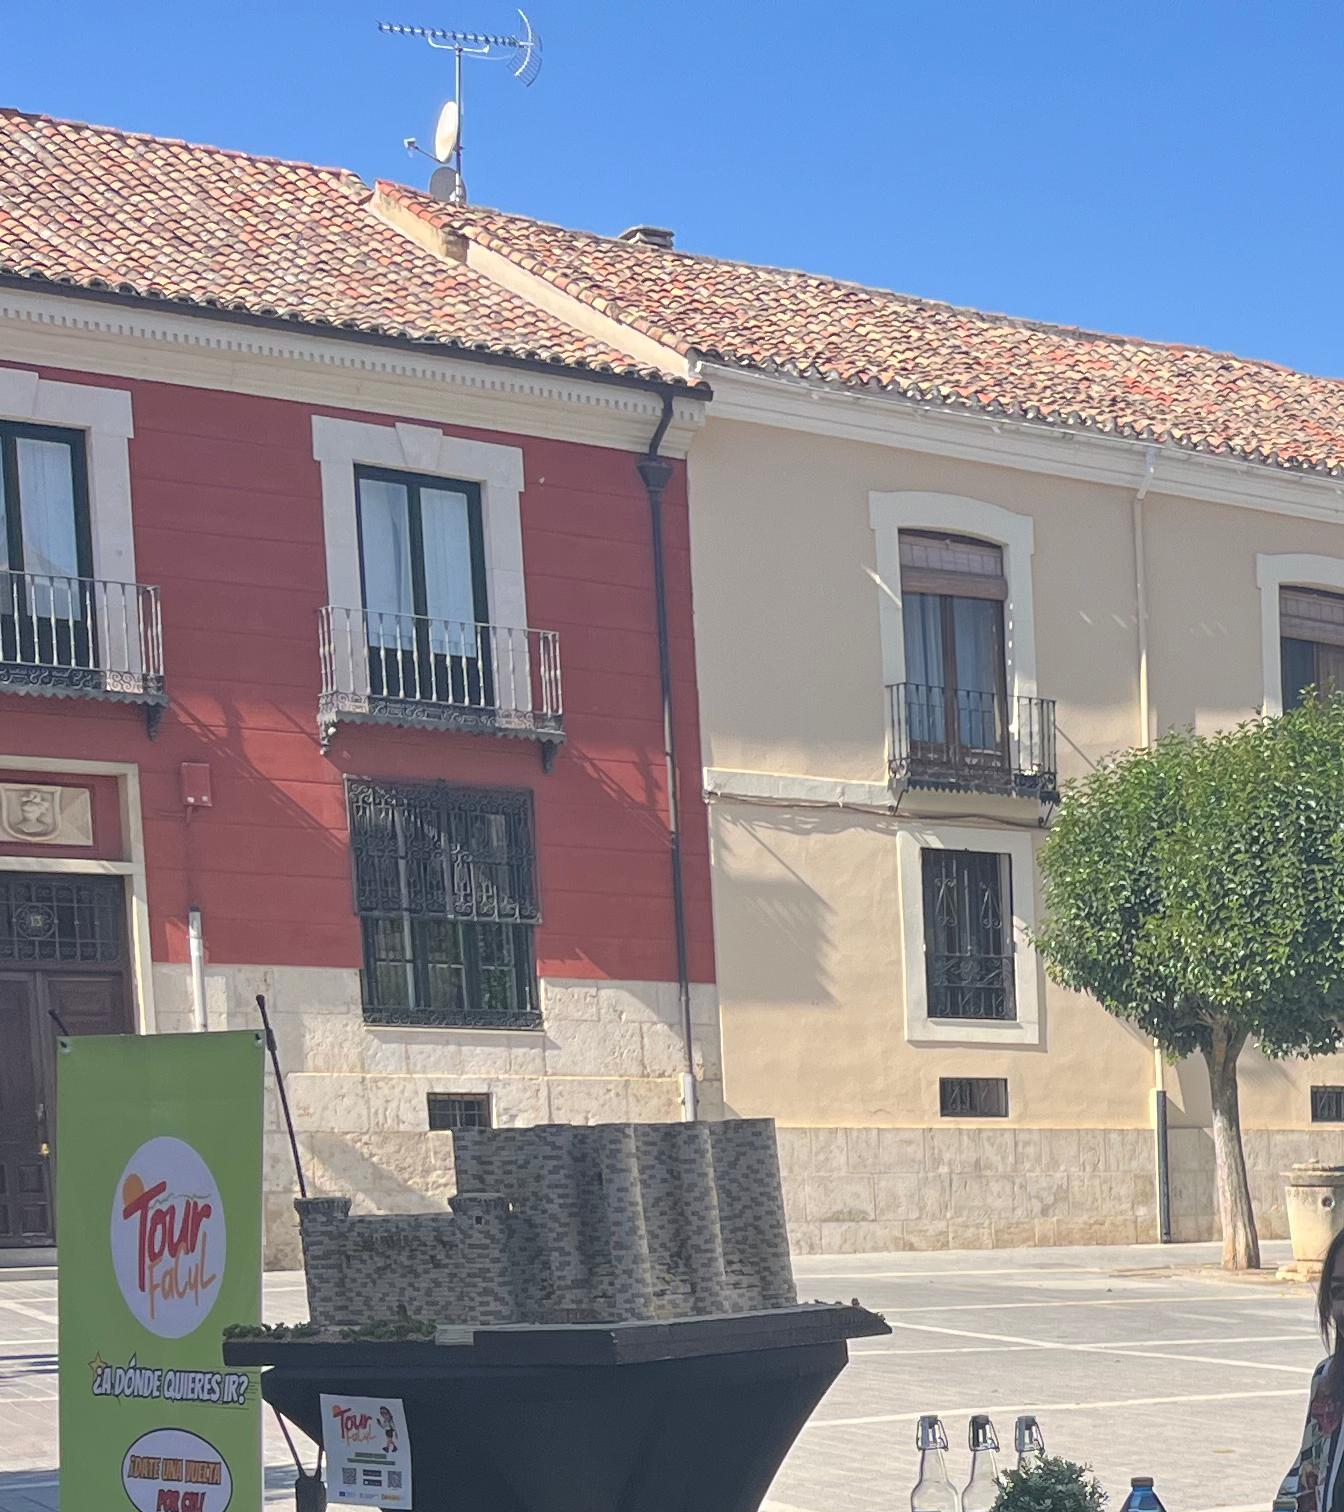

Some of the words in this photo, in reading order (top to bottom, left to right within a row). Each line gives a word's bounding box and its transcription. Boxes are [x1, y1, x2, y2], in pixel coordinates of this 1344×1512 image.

[123, 1181, 212, 1293] Tour
[93, 1366, 112, 1395] ¿A
[114, 1352, 162, 1398] DÓNDE
[164, 1369, 222, 1402] QUIERES
[223, 1373, 249, 1404] IR?
[332, 1408, 372, 1439] Tour
[162, 1458, 183, 1482] UNA
[185, 1460, 221, 1485] VUELTA
